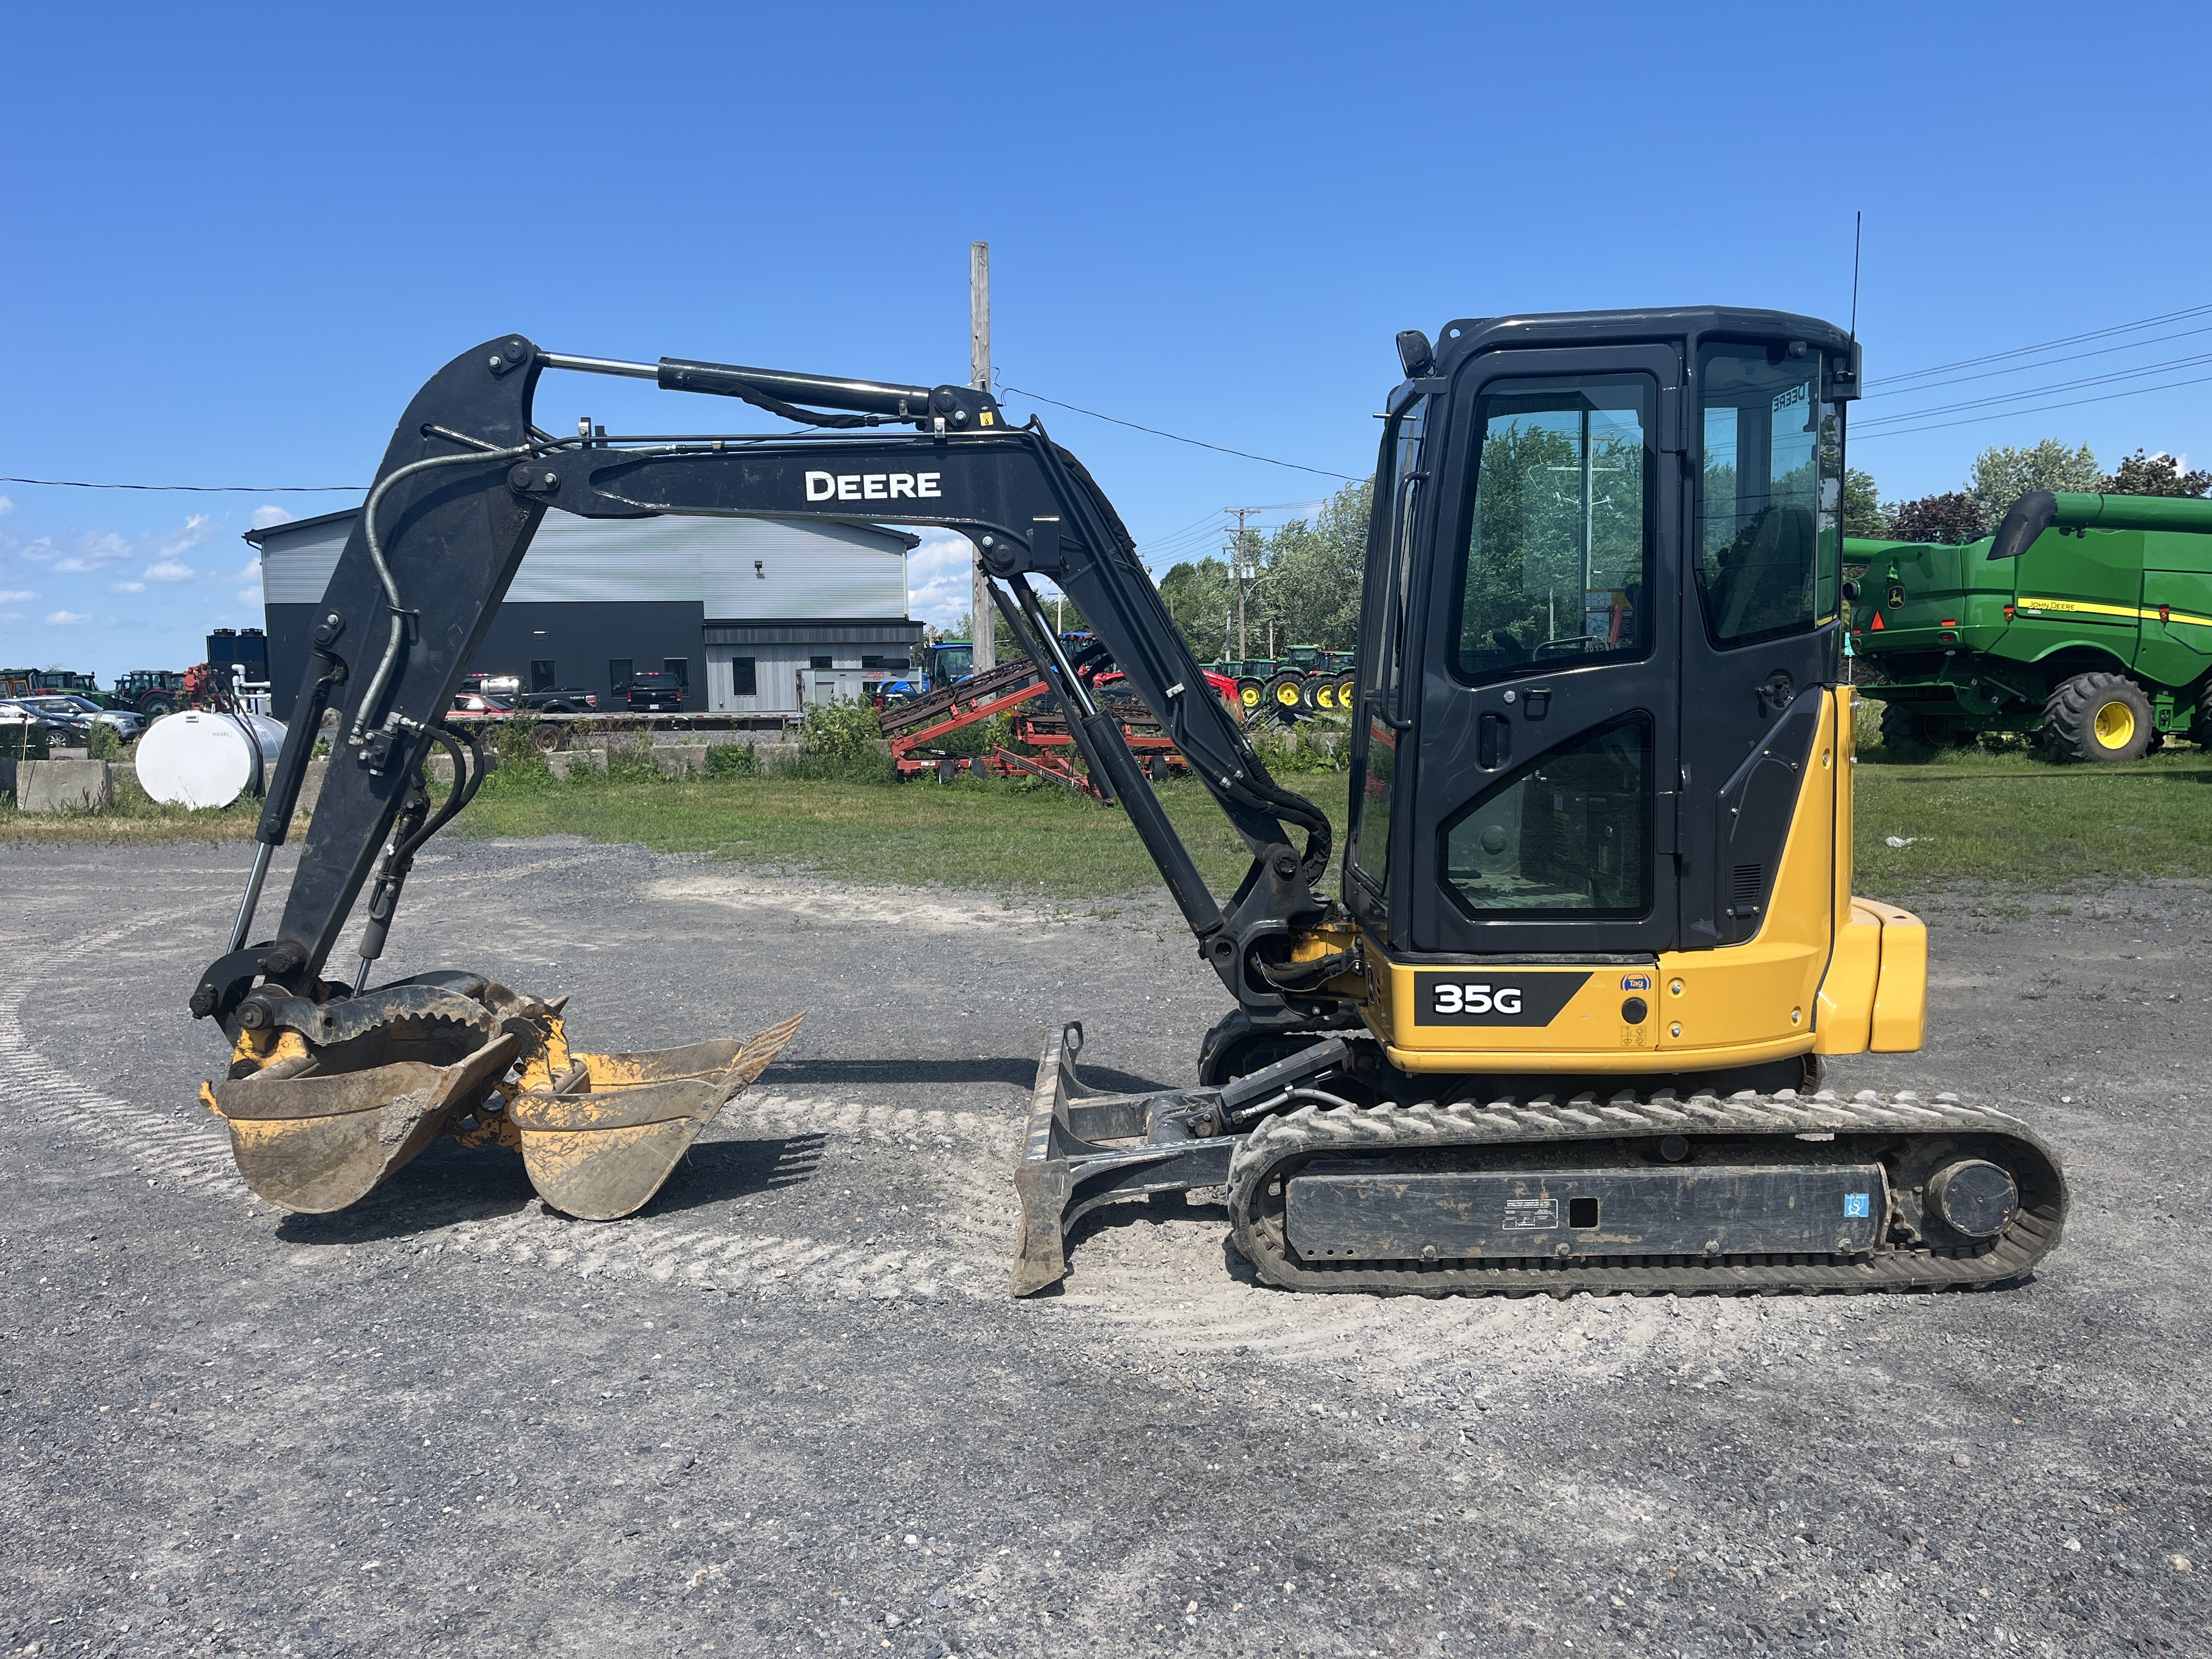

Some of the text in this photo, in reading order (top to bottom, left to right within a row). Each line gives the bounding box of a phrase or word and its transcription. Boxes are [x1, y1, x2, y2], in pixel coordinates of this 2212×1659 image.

[805, 471, 941, 501] DEERE
[2051, 602, 2075, 610] DEERE
[1628, 980, 1644, 988] Tag
[1435, 984, 1522, 1014] 35G
